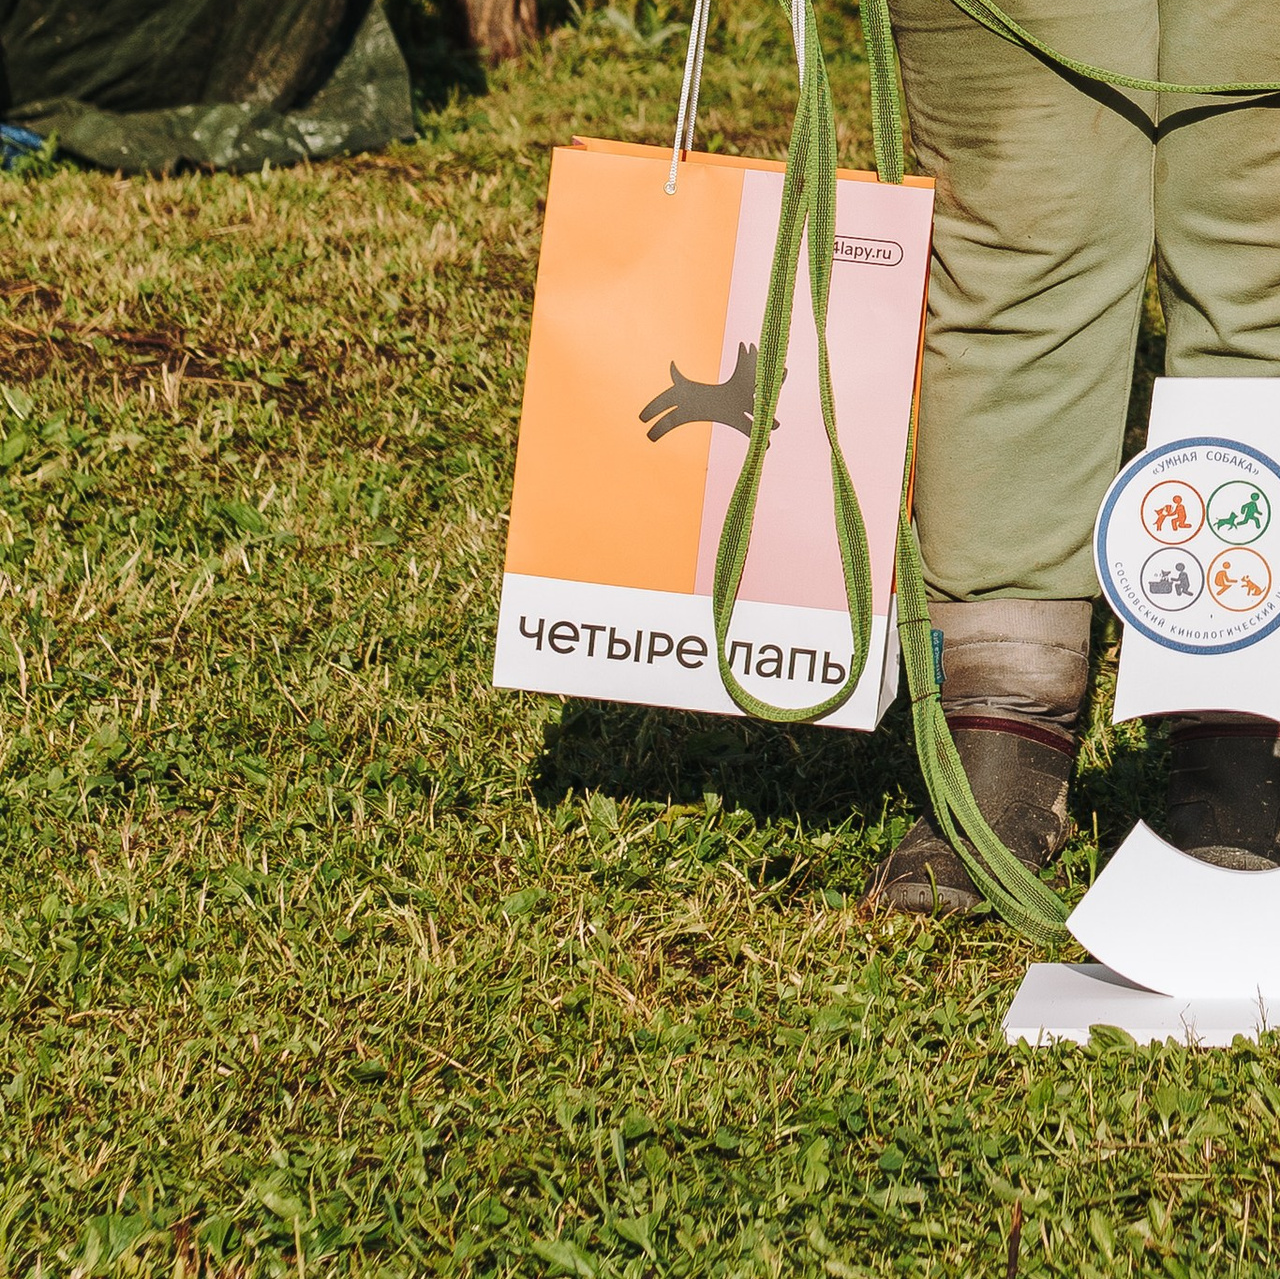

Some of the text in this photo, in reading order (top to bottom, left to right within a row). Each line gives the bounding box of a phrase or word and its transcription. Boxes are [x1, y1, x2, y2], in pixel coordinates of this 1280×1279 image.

[1152, 450, 1260, 476] «УМНАЯ СОБАКА»
[1114, 561, 1166, 627] СОСНОВСКИЙ
[1170, 602, 1276, 640] КИНОЛОГИЧЕСКИЙ
[518, 615, 709, 669] четыре
